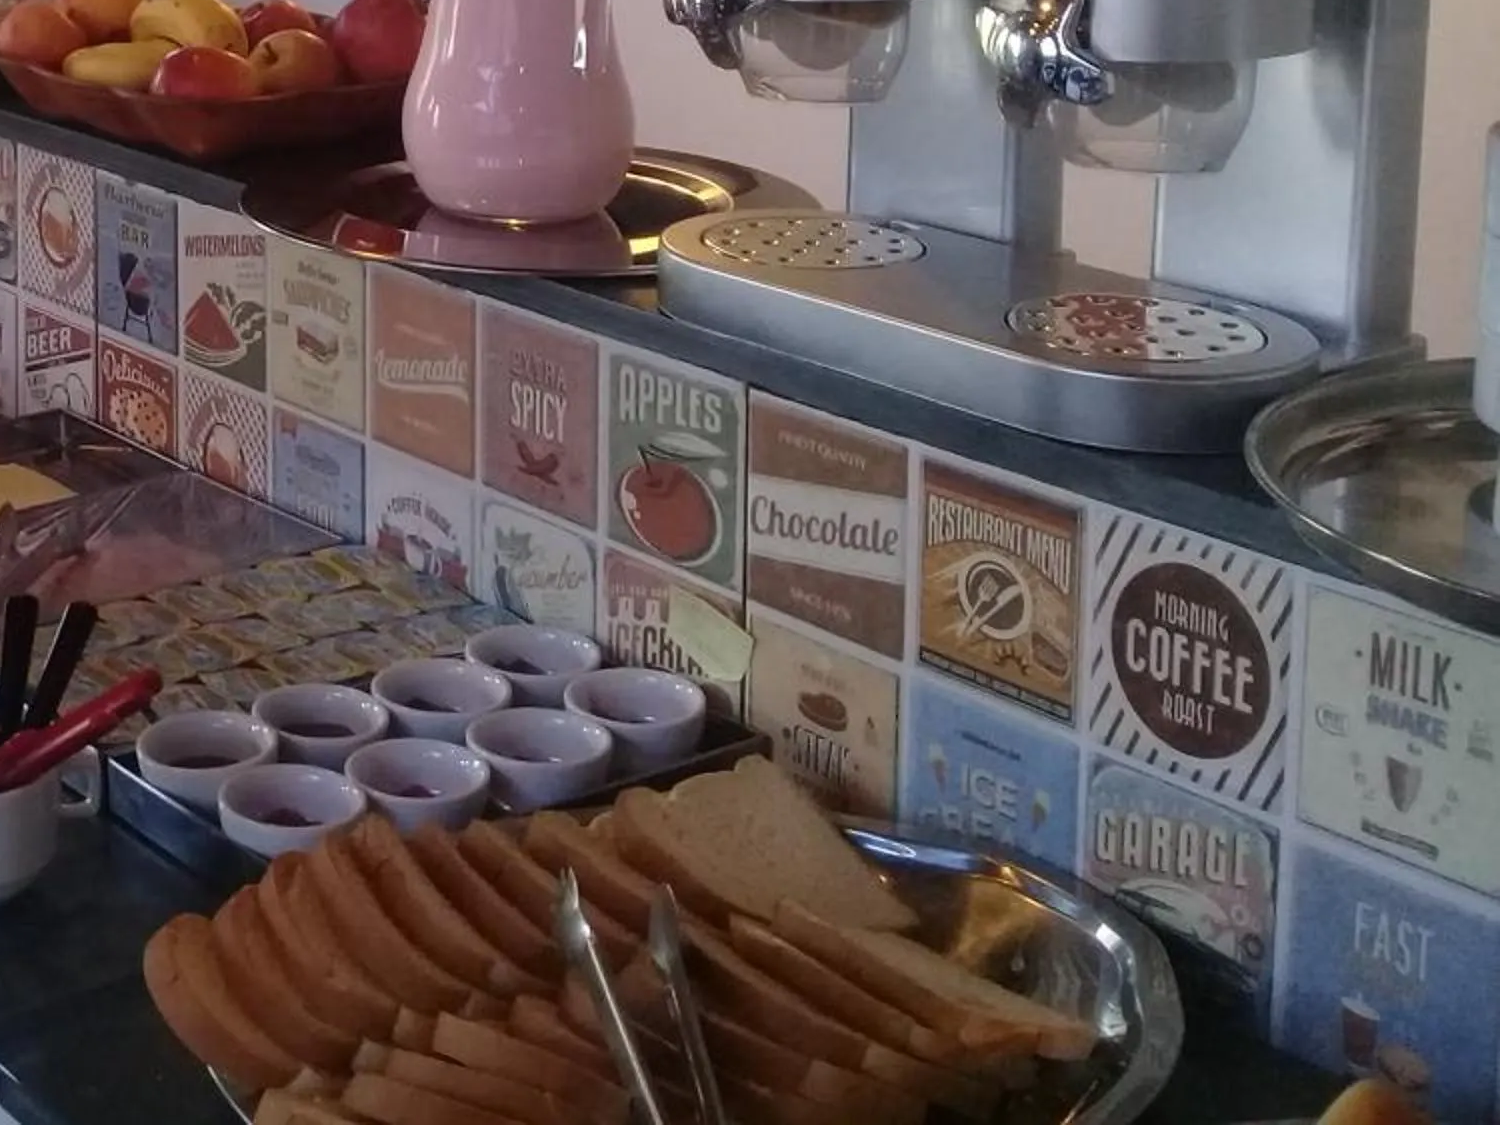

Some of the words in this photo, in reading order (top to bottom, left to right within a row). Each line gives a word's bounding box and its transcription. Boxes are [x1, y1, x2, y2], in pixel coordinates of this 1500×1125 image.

[184, 234, 266, 258] WATERMELONS
[27, 326, 71, 359] BEER
[510, 379, 568, 444] SPICY
[618, 364, 723, 434] APPLES
[749, 493, 900, 557] Chocolate
[927, 493, 1024, 558] RESTAURANT
[1025, 526, 1072, 595] MENU
[1153, 589, 1230, 642] MORNING
[1125, 618, 1254, 715] COFFEE
[1369, 631, 1452, 712] MILK
[1162, 690, 1216, 737] ROAST
[960, 761, 1020, 823] ICE
[1095, 811, 1251, 888] GARAGE
[1353, 900, 1436, 982] FAST
